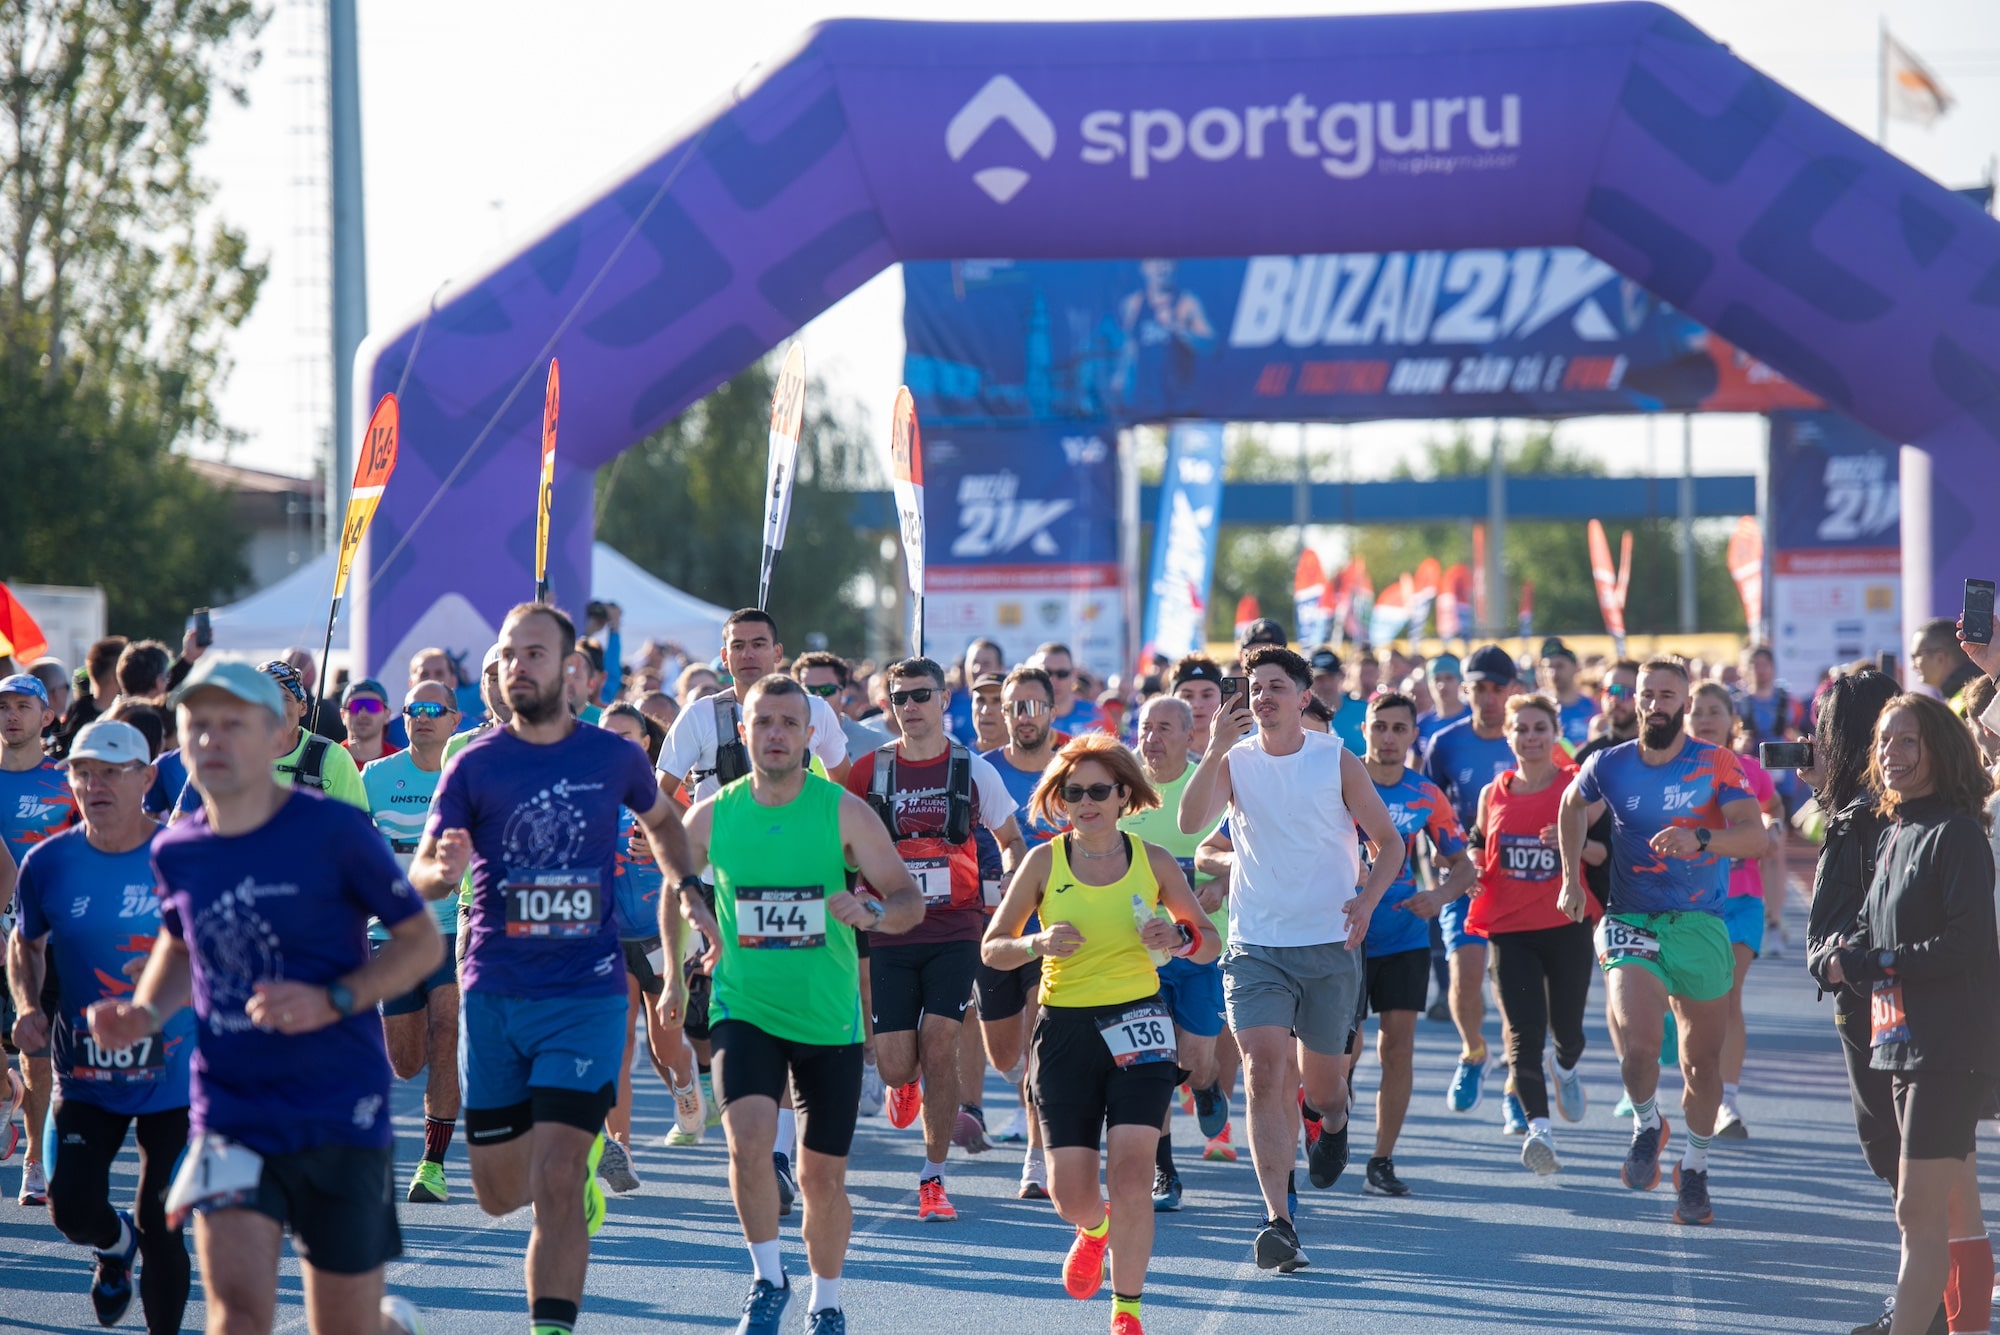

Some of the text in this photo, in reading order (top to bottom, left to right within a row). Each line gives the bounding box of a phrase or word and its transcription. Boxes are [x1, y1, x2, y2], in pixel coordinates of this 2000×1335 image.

[1081, 93, 1520, 178] sportguru
[1662, 790, 1697, 810] 21K
[1506, 847, 1555, 870] 1076
[516, 888, 592, 921] 1049
[753, 905, 807, 932] 144
[1122, 1020, 1165, 1048] 136
[83, 1036, 153, 1068] 1087
